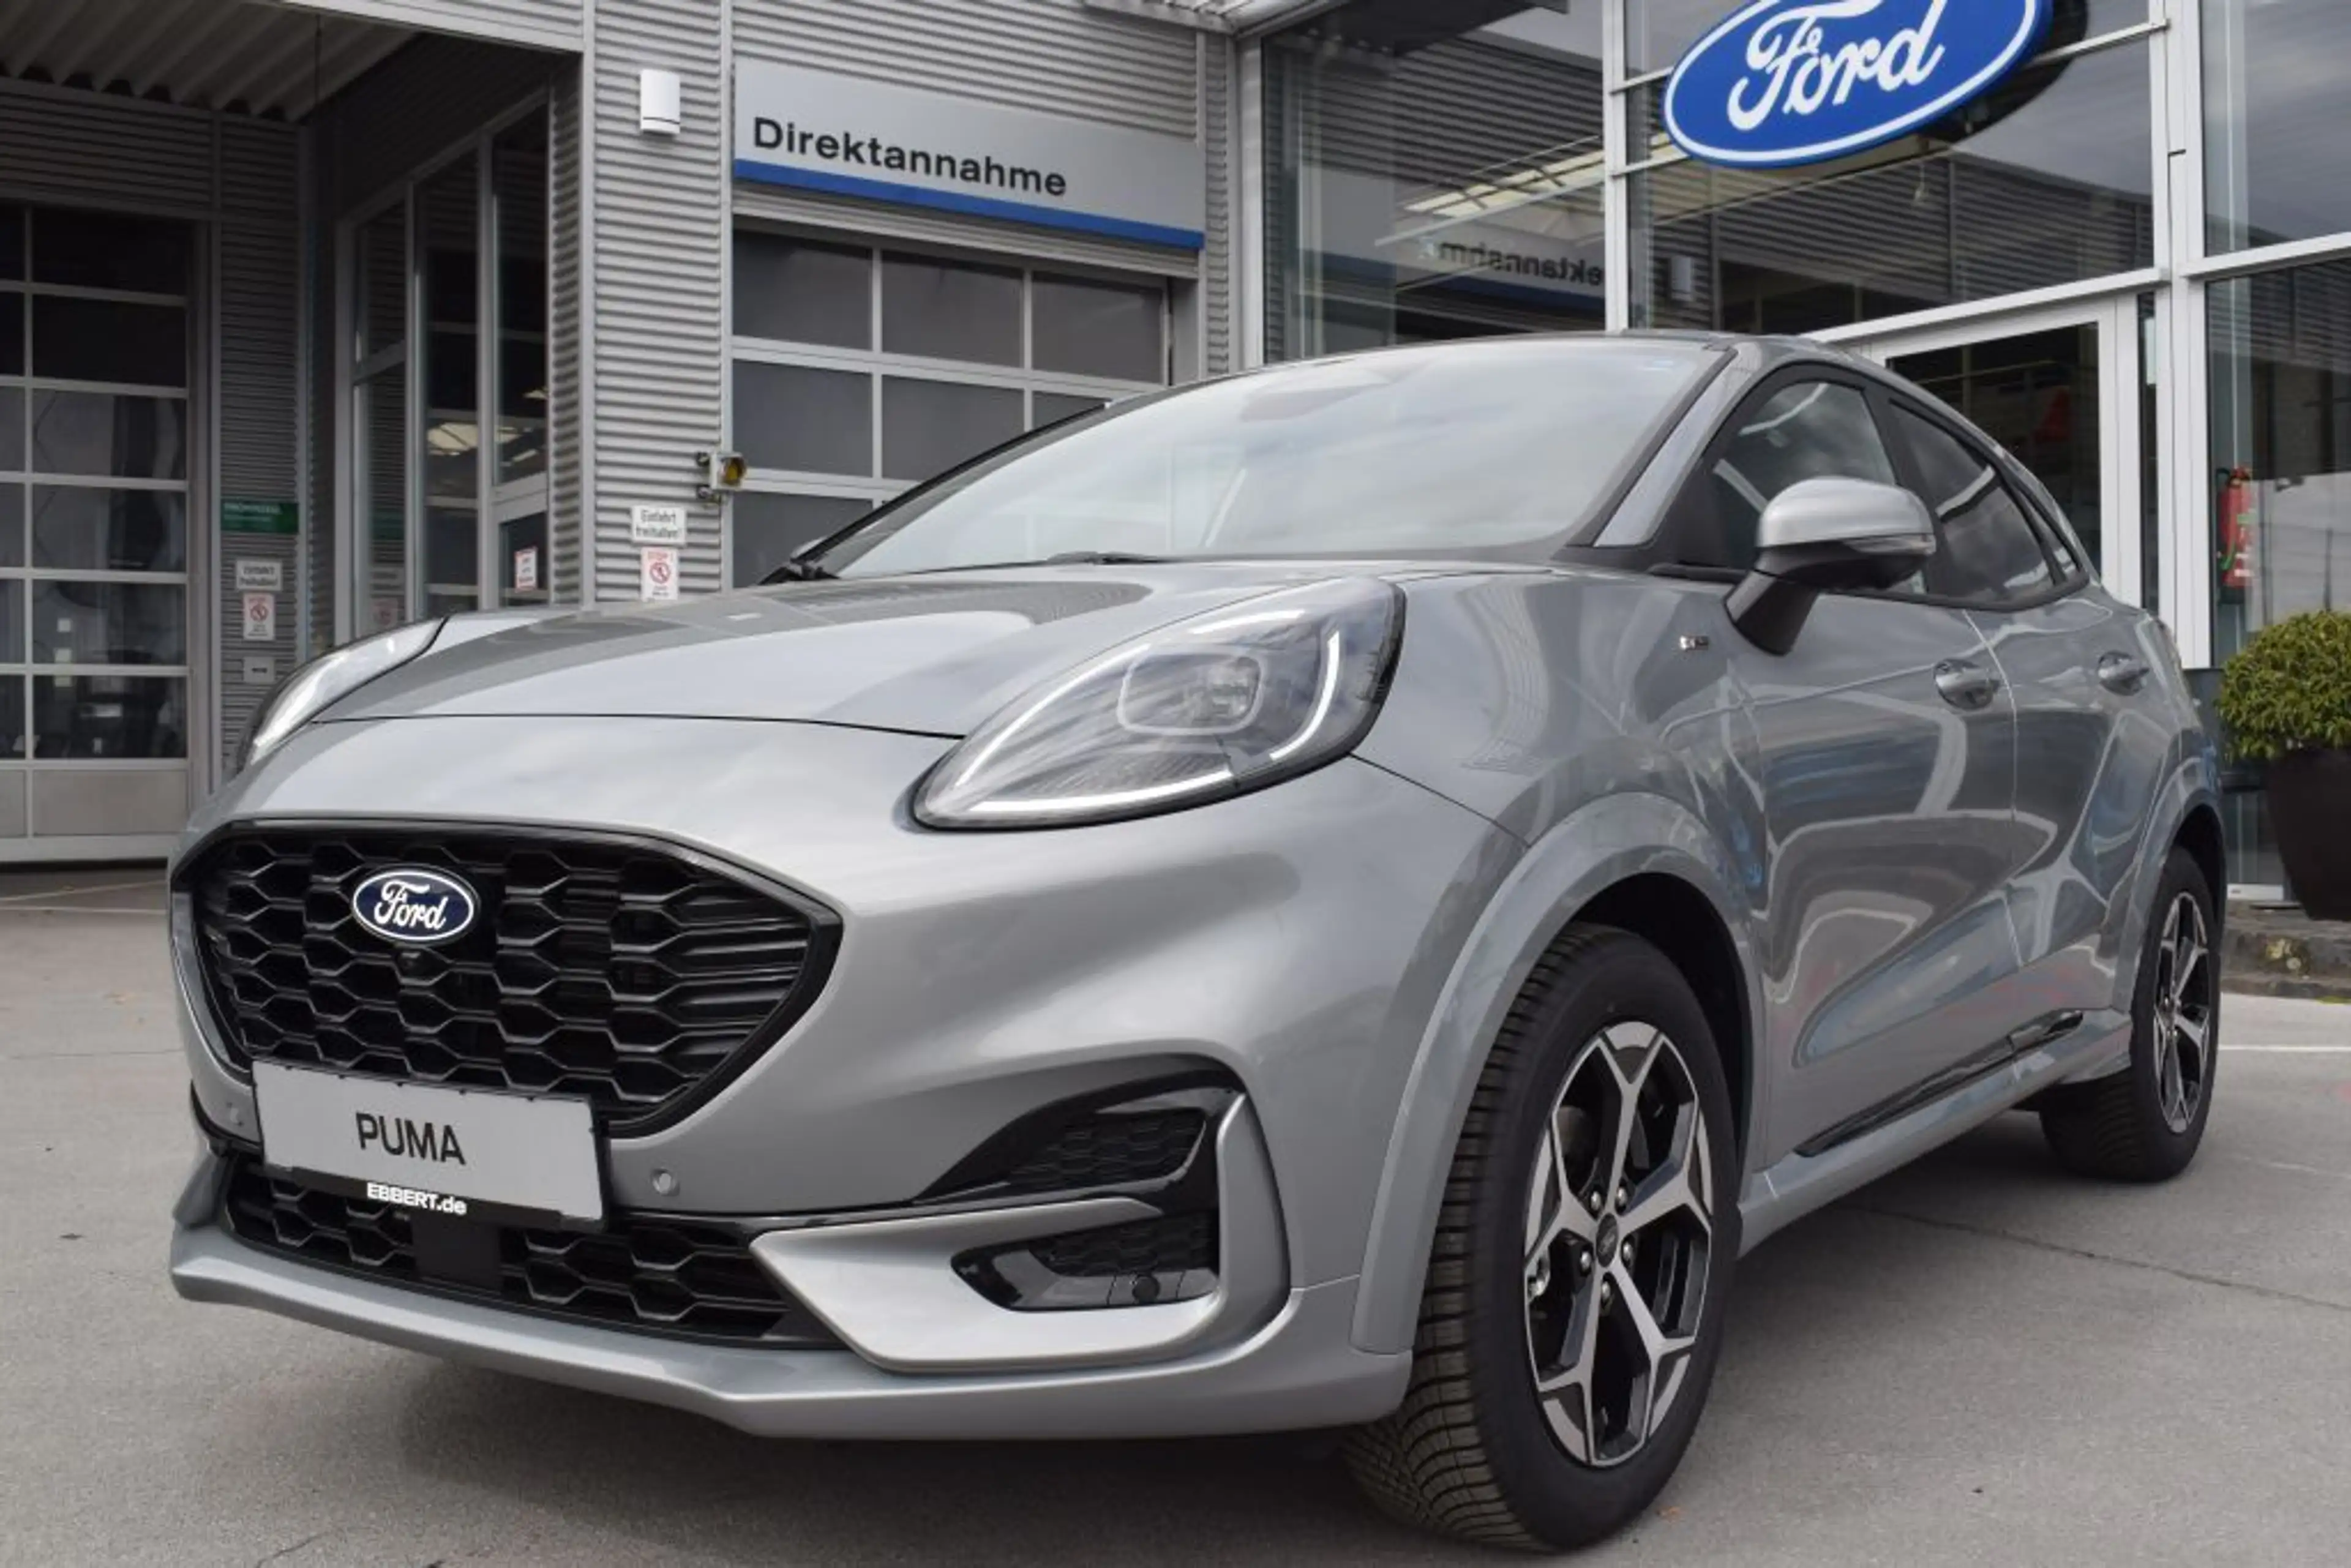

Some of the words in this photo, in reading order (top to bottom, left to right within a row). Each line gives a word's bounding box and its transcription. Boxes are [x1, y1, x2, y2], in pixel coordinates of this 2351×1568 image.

[1727, 0, 1944, 130] Ford
[754, 116, 1067, 197] Direktannahme
[374, 879, 449, 930] Ford
[356, 1112, 467, 1166] PUMA
[367, 1182, 467, 1216] EBBERT.de
